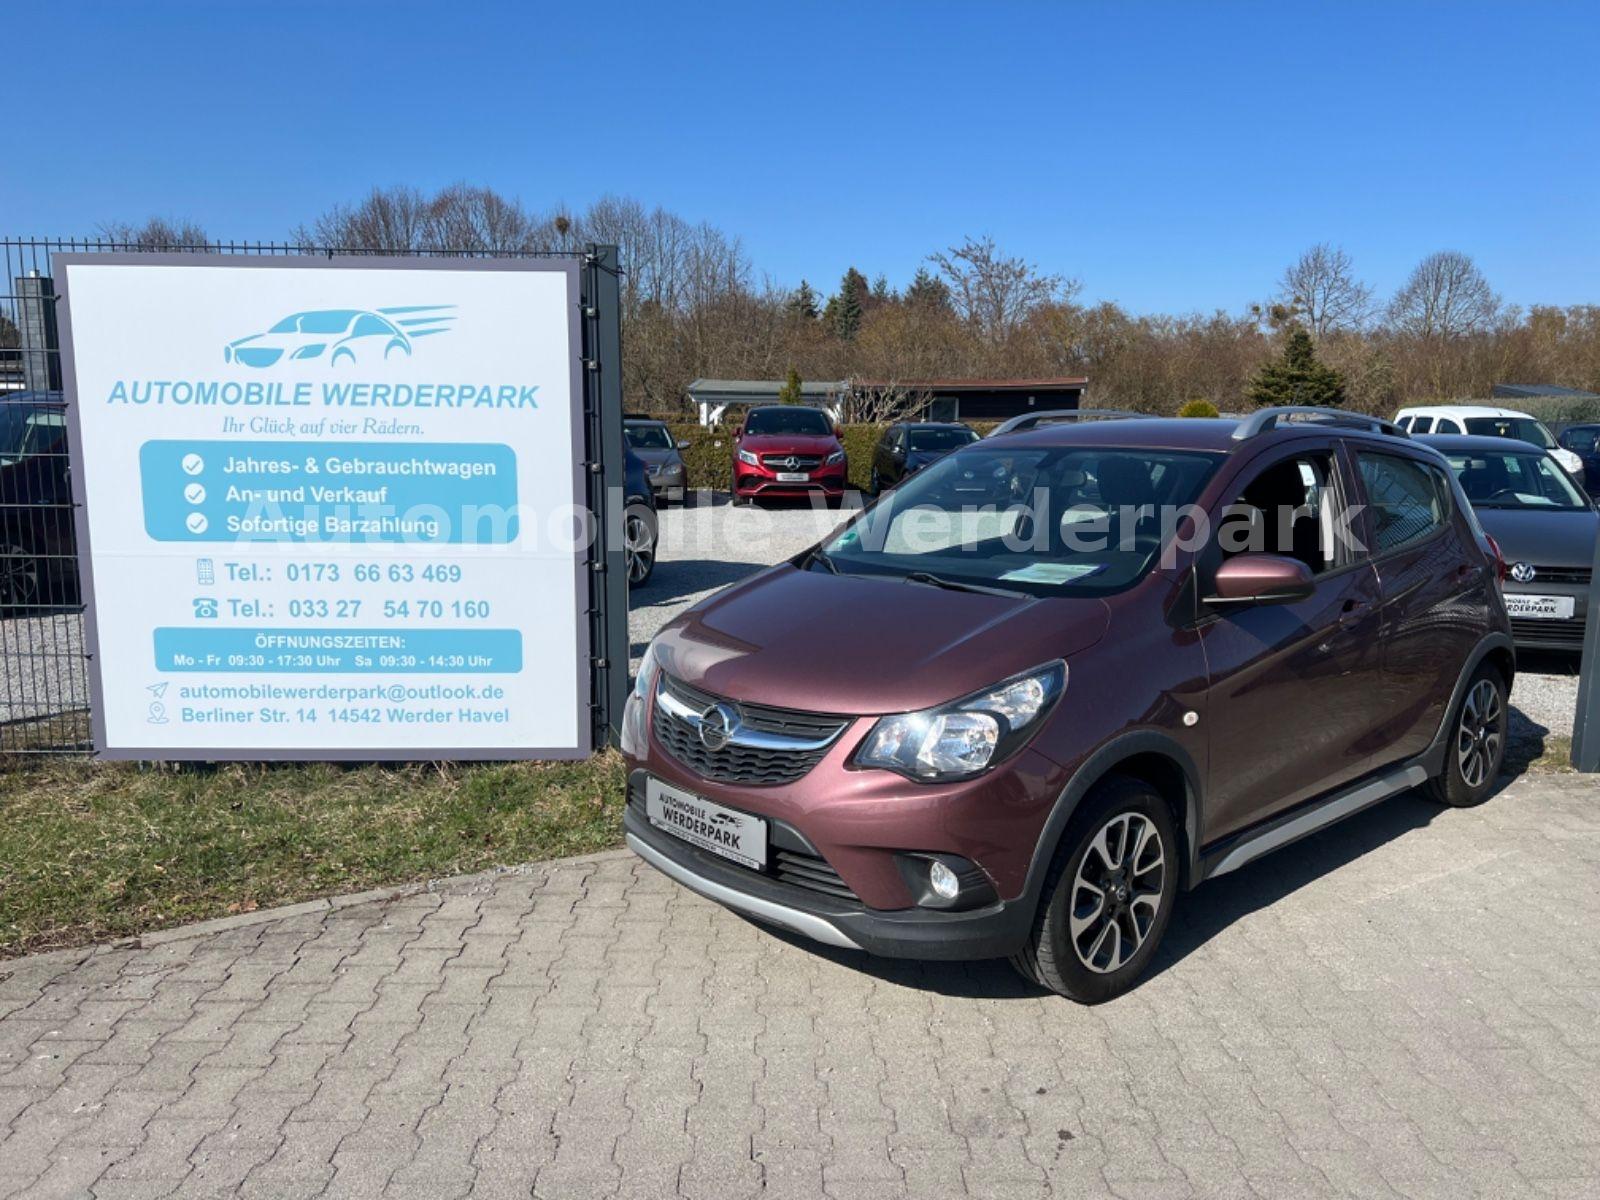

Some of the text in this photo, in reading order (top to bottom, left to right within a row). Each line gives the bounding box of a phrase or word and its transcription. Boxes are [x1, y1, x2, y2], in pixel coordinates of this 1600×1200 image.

[107, 381, 540, 409] AUTOMOBILE WERDERPARK
[222, 416, 425, 438] Ihr Glück auf vier Rädern.
[223, 457, 497, 479] Jahres- & Gebrauchtwagen
[226, 486, 388, 504] An- und Verkauf
[227, 515, 440, 538] Sofortige Barzahlung
[225, 563, 461, 583] Tel.: 0173 66 63 469
[228, 600, 490, 618] Tel.: 033 27 54 70 160
[1507, 604, 1556, 613] RDERPARK
[255, 633, 406, 649] ÖFFNUNGSZEITEN:
[174, 655, 194, 666] Mo
[207, 655, 221, 666] Fr
[228, 655, 263, 667] 09:30
[277, 655, 312, 667] 17:30
[317, 655, 341, 667] Uhr
[355, 655, 372, 667] Sa
[380, 655, 415, 667] 09:30
[428, 655, 464, 667] 14:30
[468, 655, 493, 667] Uhr
[179, 684, 504, 702] automobilewerderpark@outlook.de
[182, 707, 509, 723] Berliner Str. 14 14542 Werder Havel
[658, 793, 706, 820] AUTOMOBILE
[663, 806, 740, 849] WERDERPARK
